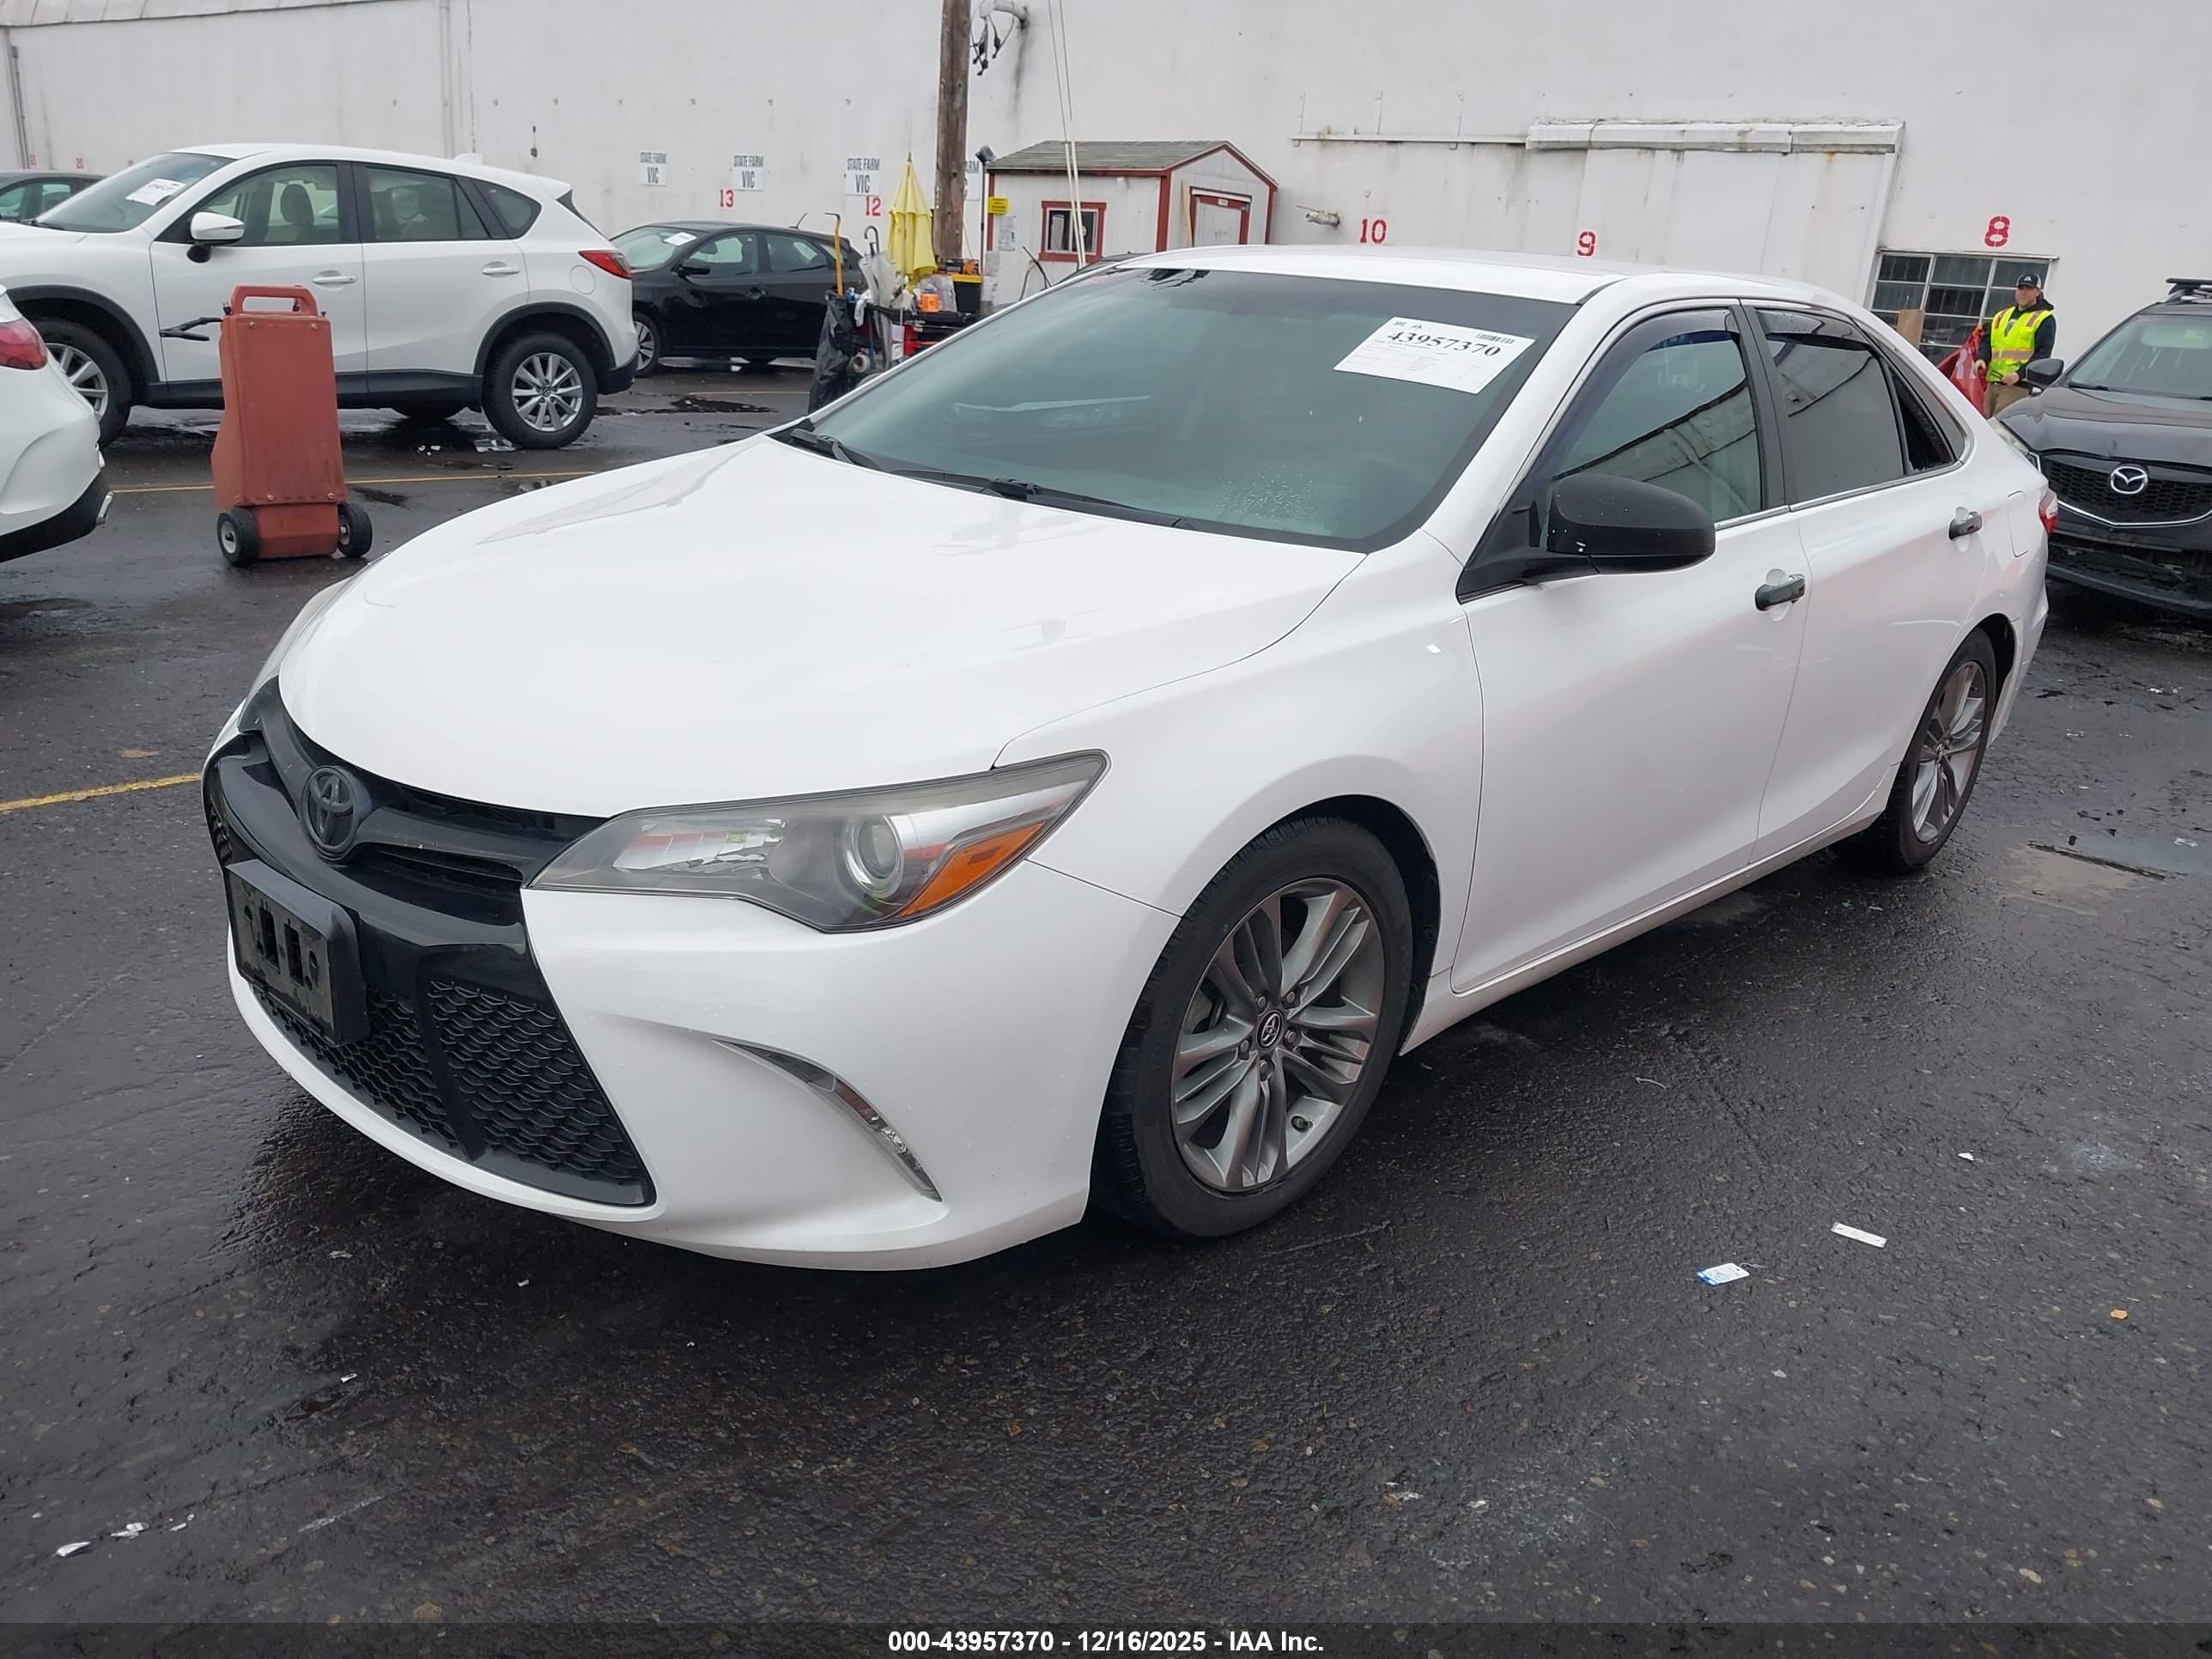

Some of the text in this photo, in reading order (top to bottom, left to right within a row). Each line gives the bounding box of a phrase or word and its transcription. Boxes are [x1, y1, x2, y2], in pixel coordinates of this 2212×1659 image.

[641, 152, 667, 164] STATE FARM
[733, 155, 764, 167] STATE FARM
[847, 157, 880, 171] STATE FARM
[647, 167, 659, 184] VIC
[741, 171, 756, 189] VIC
[855, 174, 871, 193] VIC
[720, 189, 735, 208] 13
[866, 196, 882, 216] 12
[1360, 219, 1388, 244] 10
[1984, 216, 2010, 247] 8
[1577, 231, 1596, 257] 9
[1388, 331, 1501, 356] 43957370
